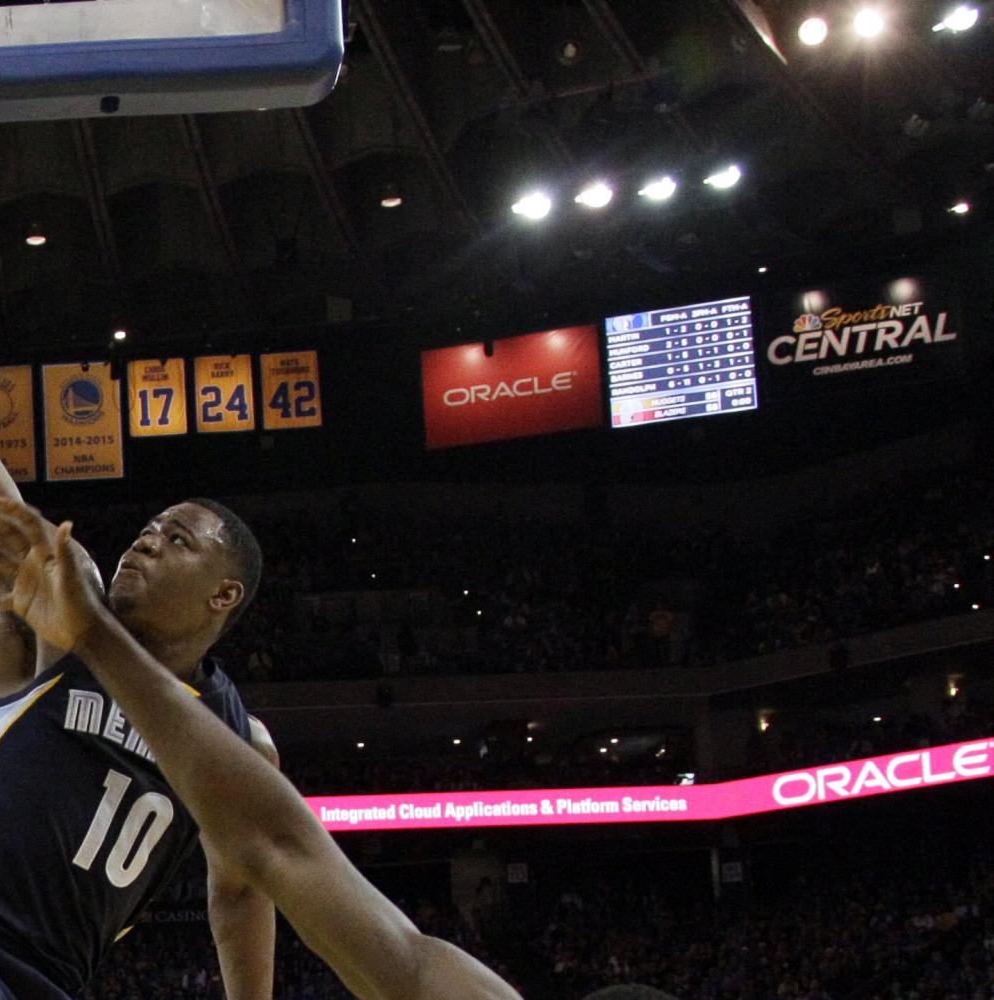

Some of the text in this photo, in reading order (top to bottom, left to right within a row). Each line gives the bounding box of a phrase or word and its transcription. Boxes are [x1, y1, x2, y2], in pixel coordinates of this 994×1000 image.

[767, 312, 957, 365] CENTRAL
[138, 387, 174, 427] 17
[201, 384, 249, 423] 24
[269, 380, 316, 419] 42
[443, 371, 573, 406] ORACLE
[54, 436, 114, 447] 2014-2015
[55, 464, 114, 475] CHAMPIONS
[773, 741, 992, 805] ORACLE
[72, 769, 174, 888] 10
[320, 796, 687, 824] Integrated Cloud Applications & Platform Services
